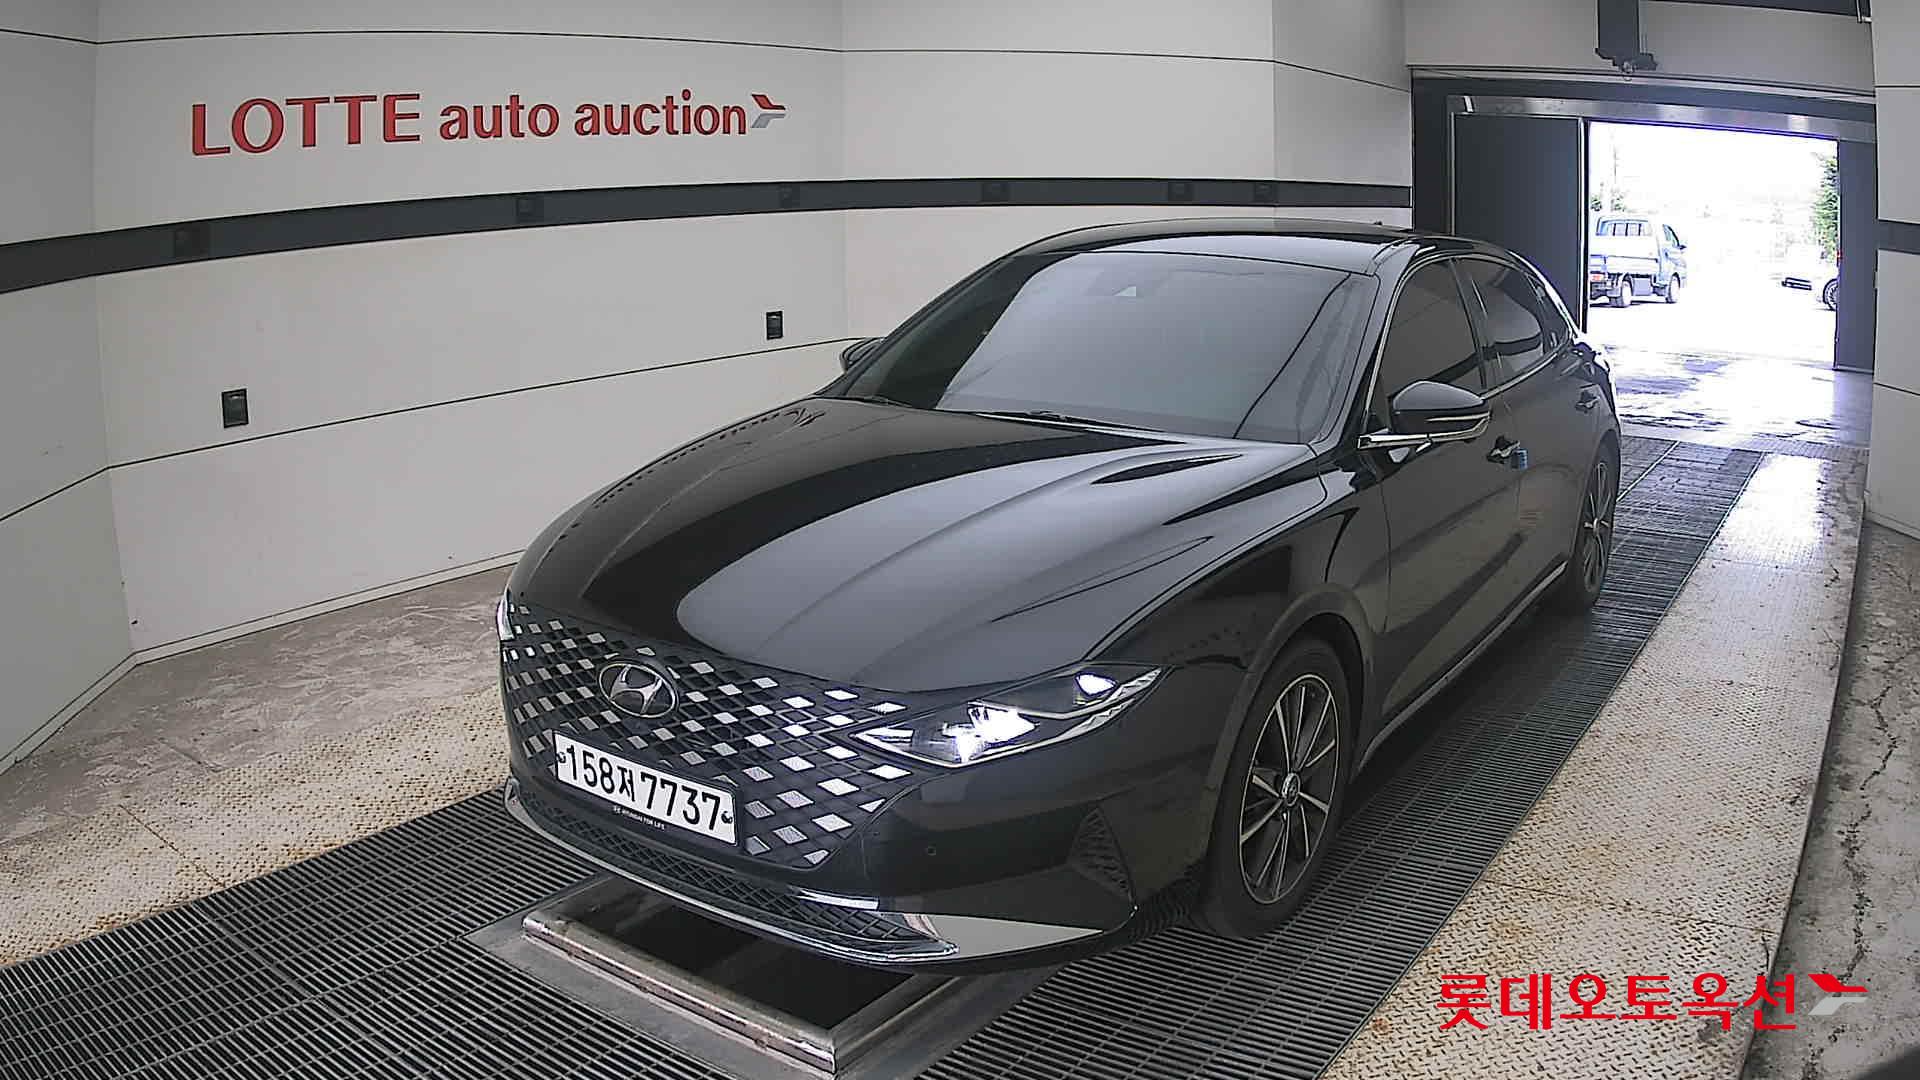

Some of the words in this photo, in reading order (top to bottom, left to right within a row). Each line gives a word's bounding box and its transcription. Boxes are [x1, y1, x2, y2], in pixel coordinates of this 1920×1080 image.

[191, 93, 421, 157] LOTTE
[438, 94, 560, 140] auto
[574, 89, 748, 137] auction
